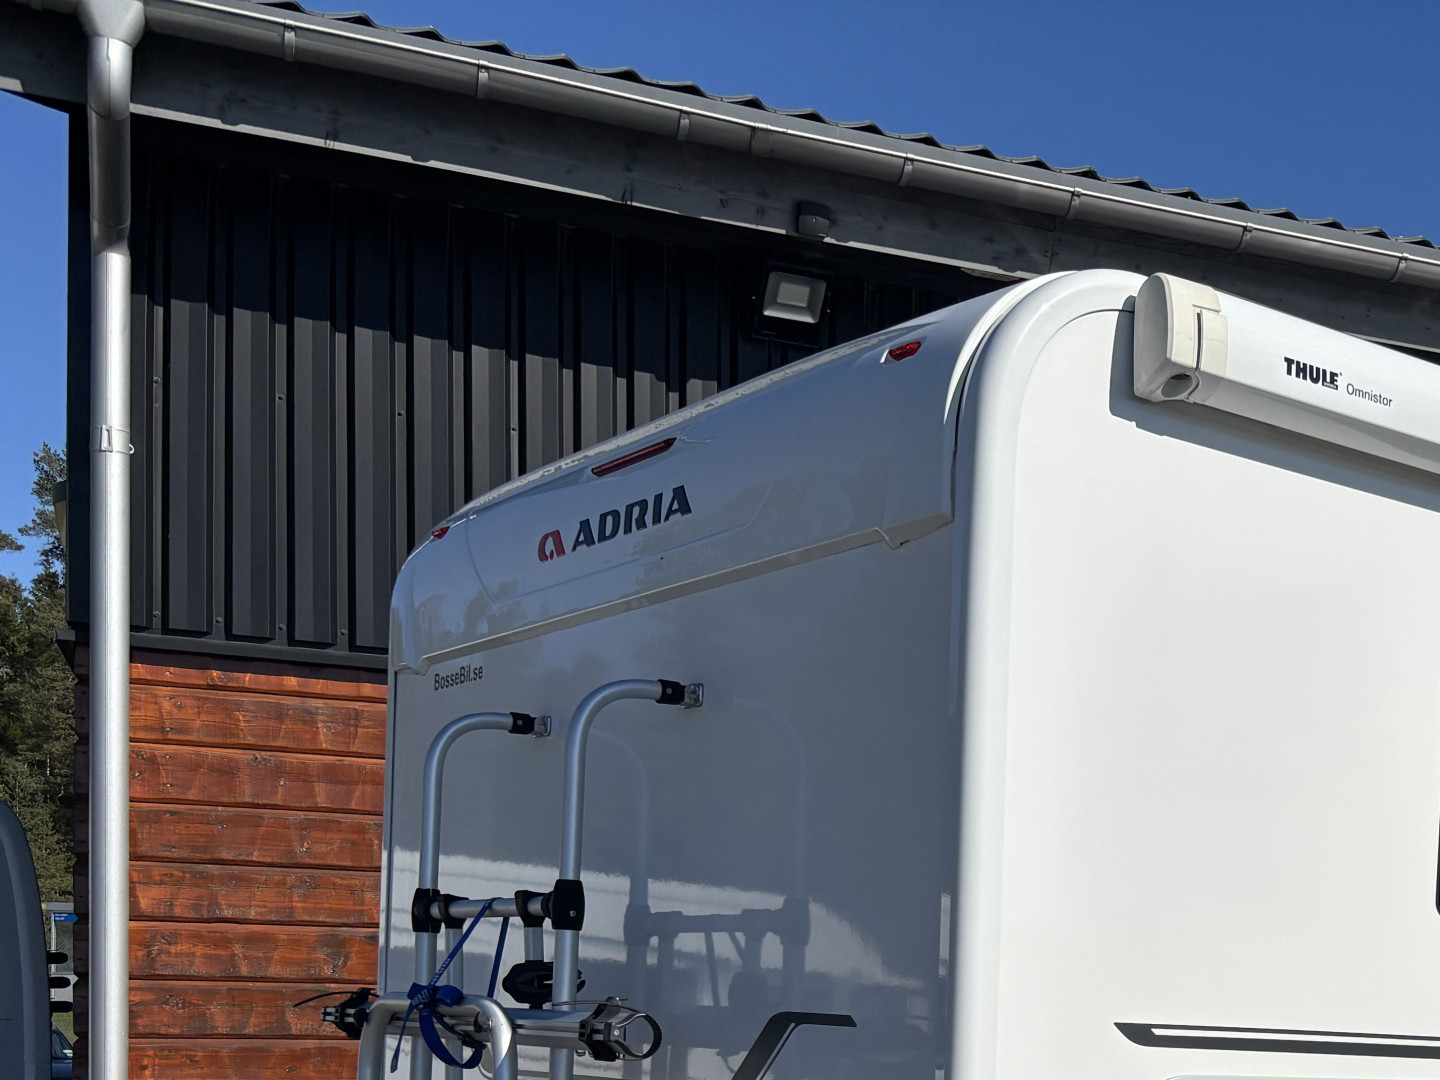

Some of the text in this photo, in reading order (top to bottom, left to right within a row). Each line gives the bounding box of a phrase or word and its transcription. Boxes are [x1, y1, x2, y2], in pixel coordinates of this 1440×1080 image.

[1283, 356, 1393, 407] THULE Omnistor
[571, 484, 693, 553] ADRIA
[434, 664, 484, 691] BosseBil.se
